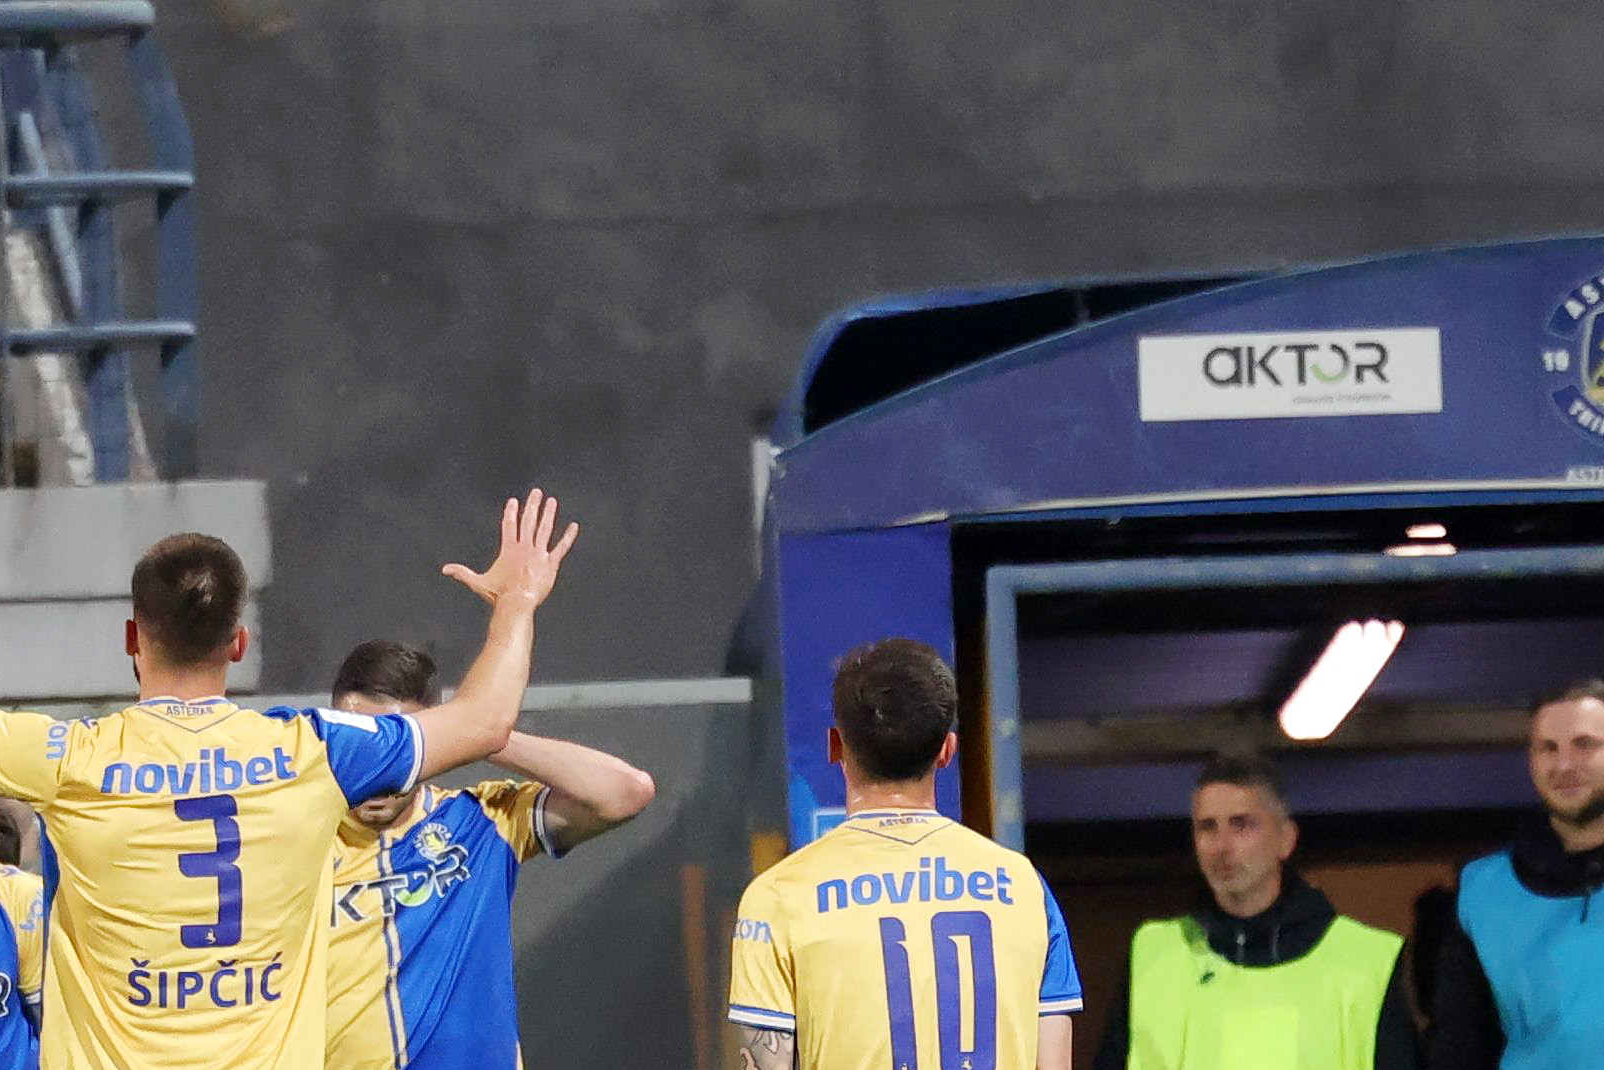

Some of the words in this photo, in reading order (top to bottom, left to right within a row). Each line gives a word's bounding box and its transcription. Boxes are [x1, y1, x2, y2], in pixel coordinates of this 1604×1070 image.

[100, 747, 296, 795] novibet
[174, 793, 243, 948] 3
[330, 844, 472, 928] KTOR
[816, 857, 1015, 913] novibet
[127, 951, 284, 1009] ŠIPČIĆ
